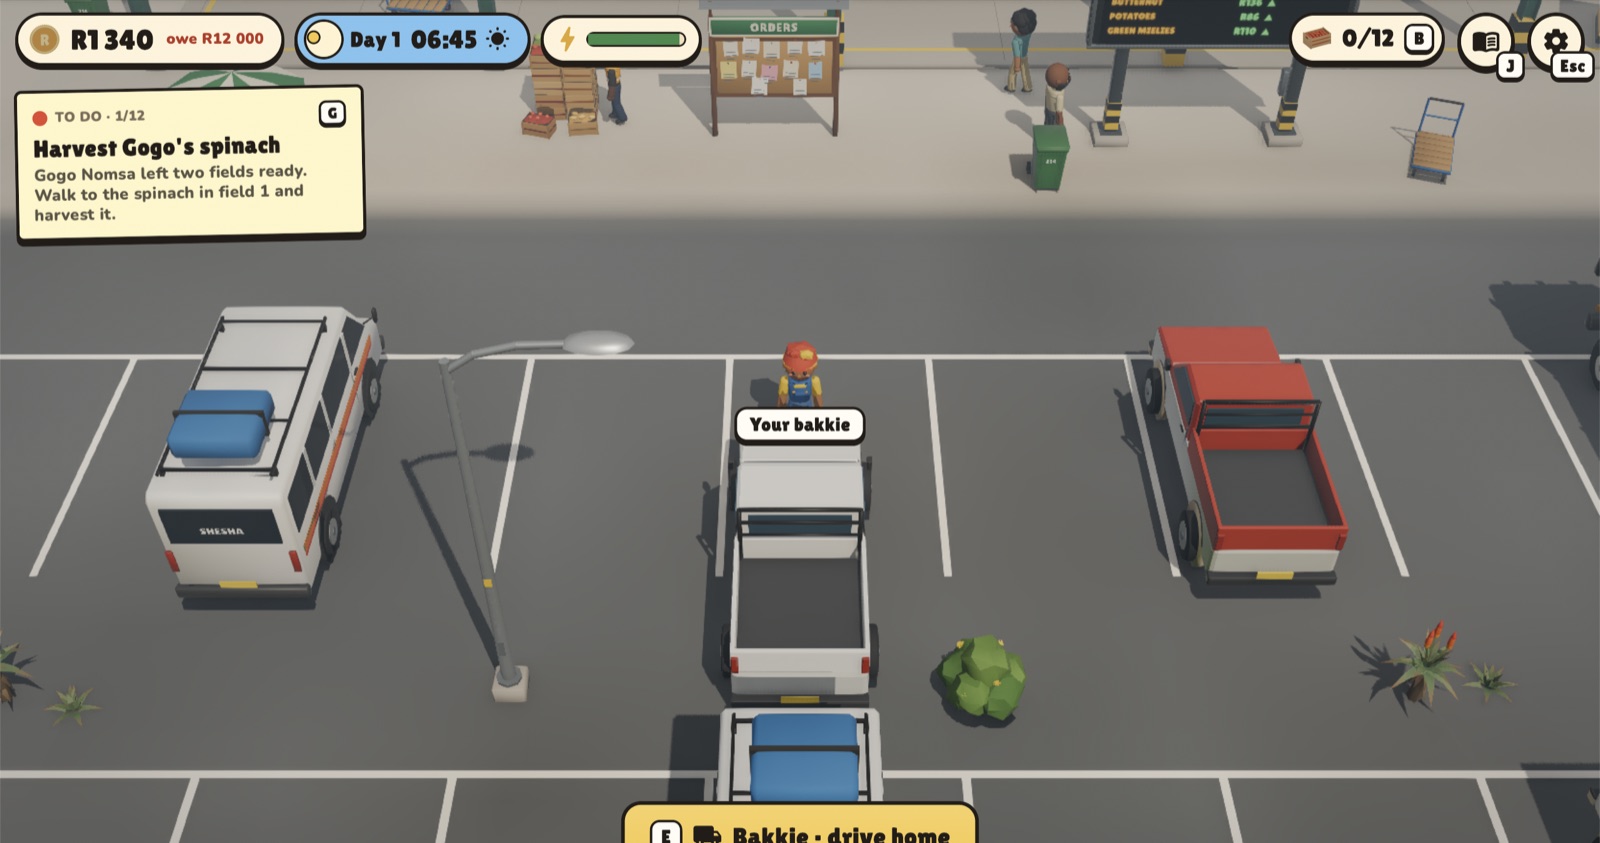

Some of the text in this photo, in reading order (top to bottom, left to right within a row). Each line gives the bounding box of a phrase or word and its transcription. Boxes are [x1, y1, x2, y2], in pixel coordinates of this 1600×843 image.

[1109, 12, 1156, 20] POTATOES
[1240, 13, 1259, 21] R86
[750, 23, 797, 32] ORDERS
[1107, 27, 1176, 35] GREEN MIELIES
[199, 527, 245, 535] SHESHA
